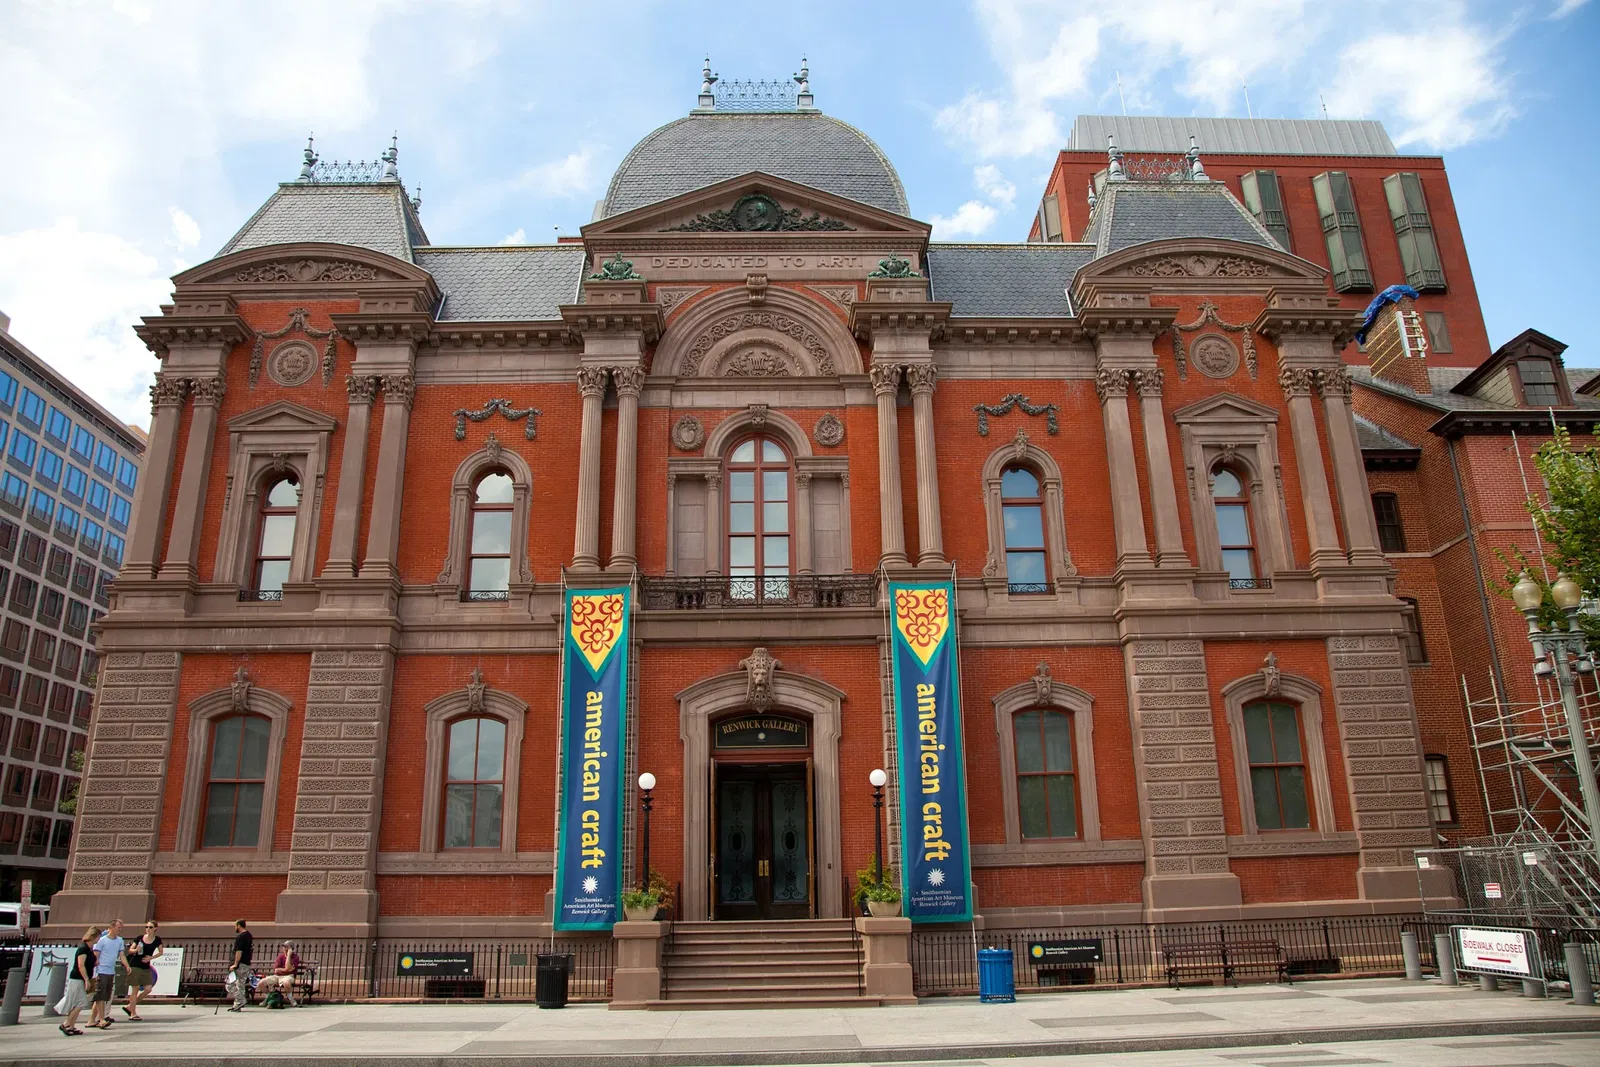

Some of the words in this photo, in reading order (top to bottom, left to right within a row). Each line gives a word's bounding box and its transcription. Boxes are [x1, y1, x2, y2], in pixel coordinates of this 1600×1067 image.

[651, 256, 768, 269] DEDICATED
[779, 256, 806, 268] TO
[582, 691, 608, 802] american
[722, 719, 761, 734] RENWICK
[762, 719, 801, 733] GALLERY
[915, 683, 946, 794] american
[580, 810, 606, 869] craft
[922, 802, 952, 861] craft
[1462, 939, 1494, 951] SIDEWALK
[1496, 942, 1524, 953] CLOSED
